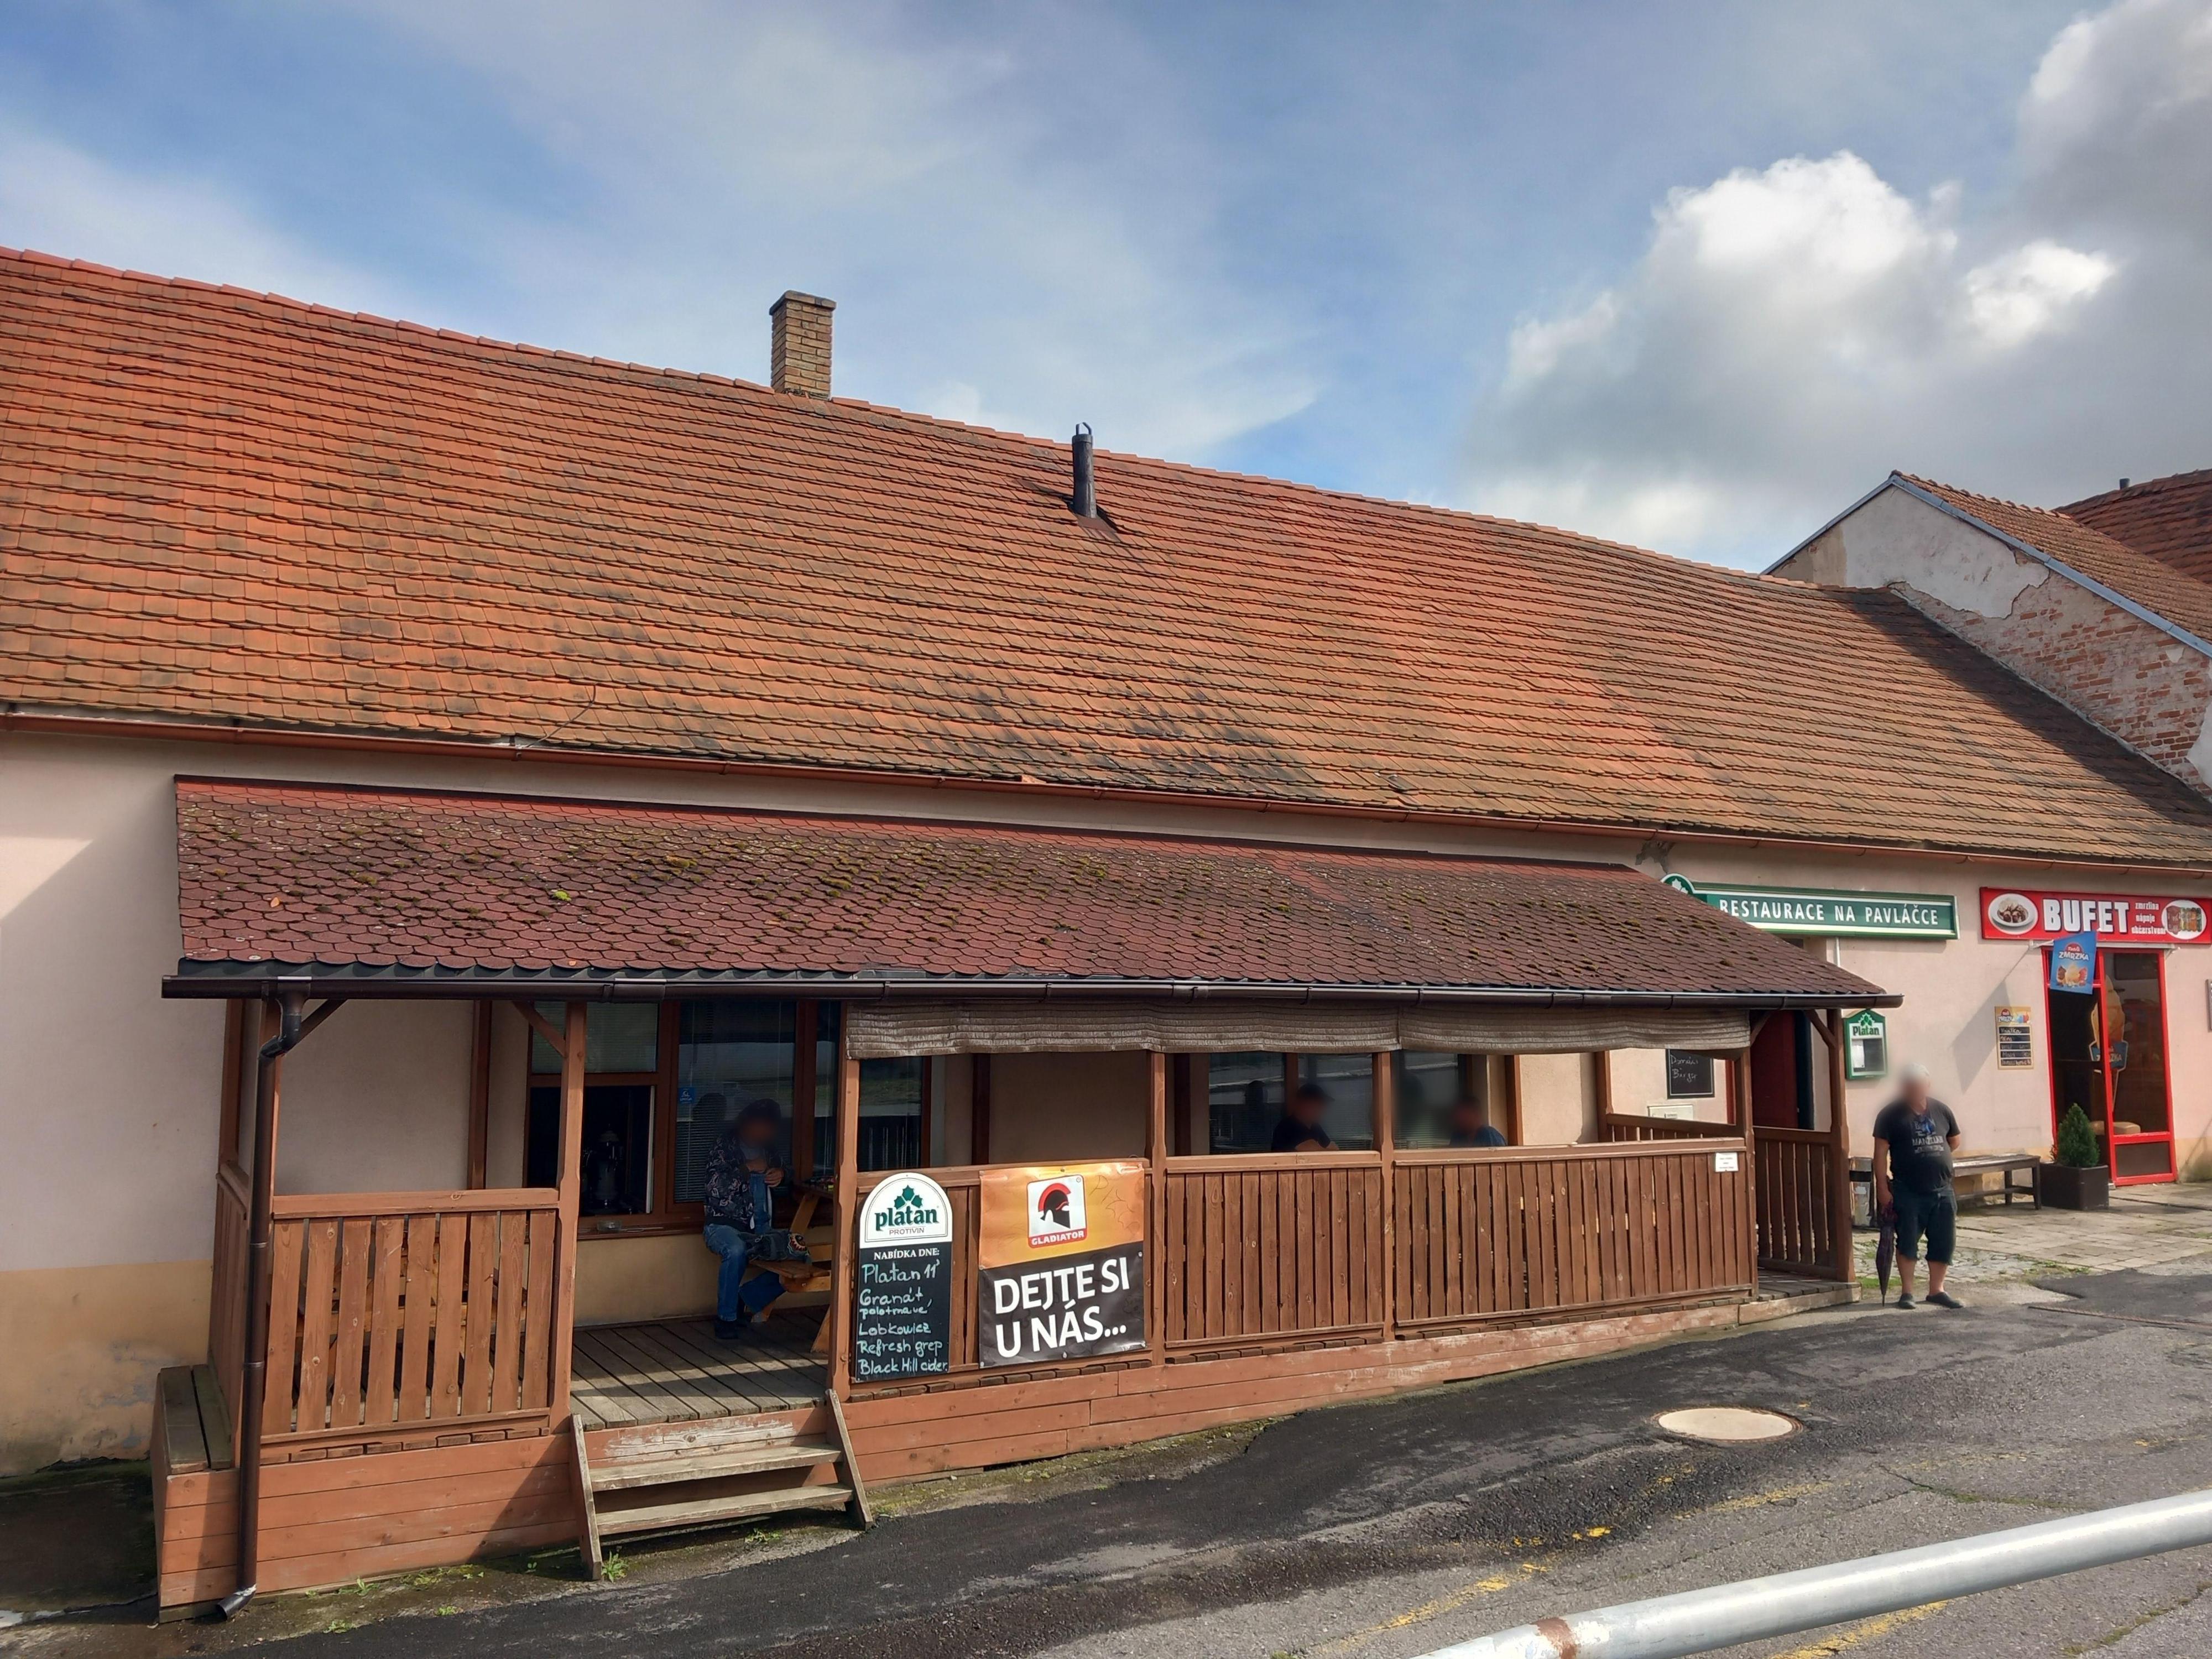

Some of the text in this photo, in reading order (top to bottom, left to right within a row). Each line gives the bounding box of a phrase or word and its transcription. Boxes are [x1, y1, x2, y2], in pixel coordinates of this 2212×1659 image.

[1719, 899, 1938, 925] RESTAURACE NA PAVLÁČCE
[2043, 899, 2129, 933] BUFET
[1852, 1025, 1880, 1036] Platan
[874, 1206, 939, 1232] platan
[1031, 1230, 1084, 1245] GLADIATOR
[874, 1248, 940, 1260] NABÍDKA DNE:
[862, 1261, 921, 1284] Platan
[994, 1256, 1130, 1314] DEJTE SI
[858, 1322, 931, 1336] Lobkowicz
[996, 1299, 1126, 1358] U NÁS...
[857, 1338, 943, 1357] Refresh grep
[858, 1358, 900, 1375] Black
[901, 1357, 918, 1372] Hill
